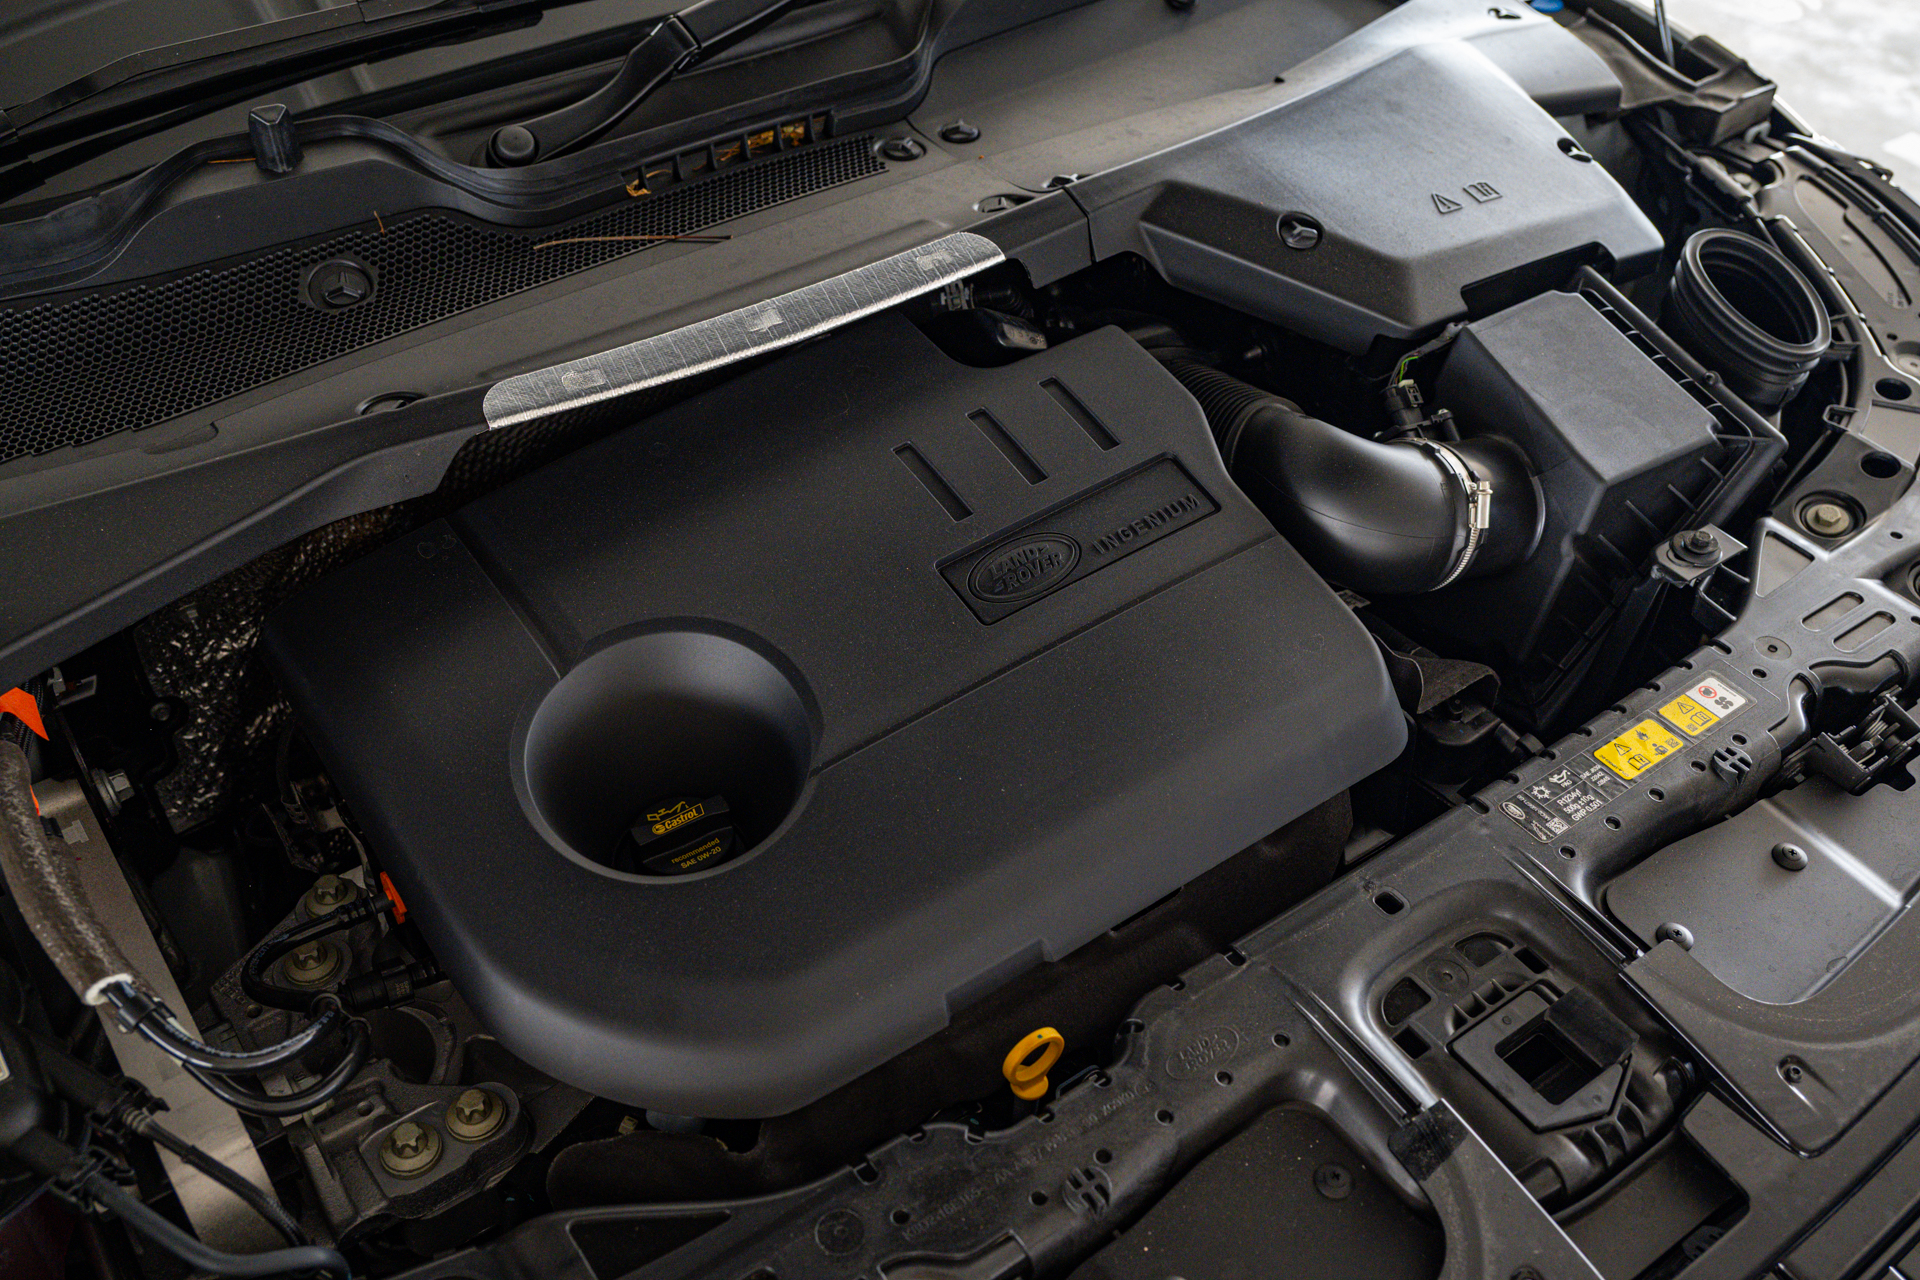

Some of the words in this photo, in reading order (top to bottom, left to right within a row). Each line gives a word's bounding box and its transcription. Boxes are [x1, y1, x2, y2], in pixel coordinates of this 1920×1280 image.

[1090, 493, 1201, 556] INGENIUM
[989, 545, 1040, 582] LAND
[1005, 551, 1066, 594] ROVER
[664, 808, 699, 830] Castrol
[671, 837, 721, 864] recommended
[680, 859, 698, 869] SAE
[697, 845, 722, 862] 0W-20
